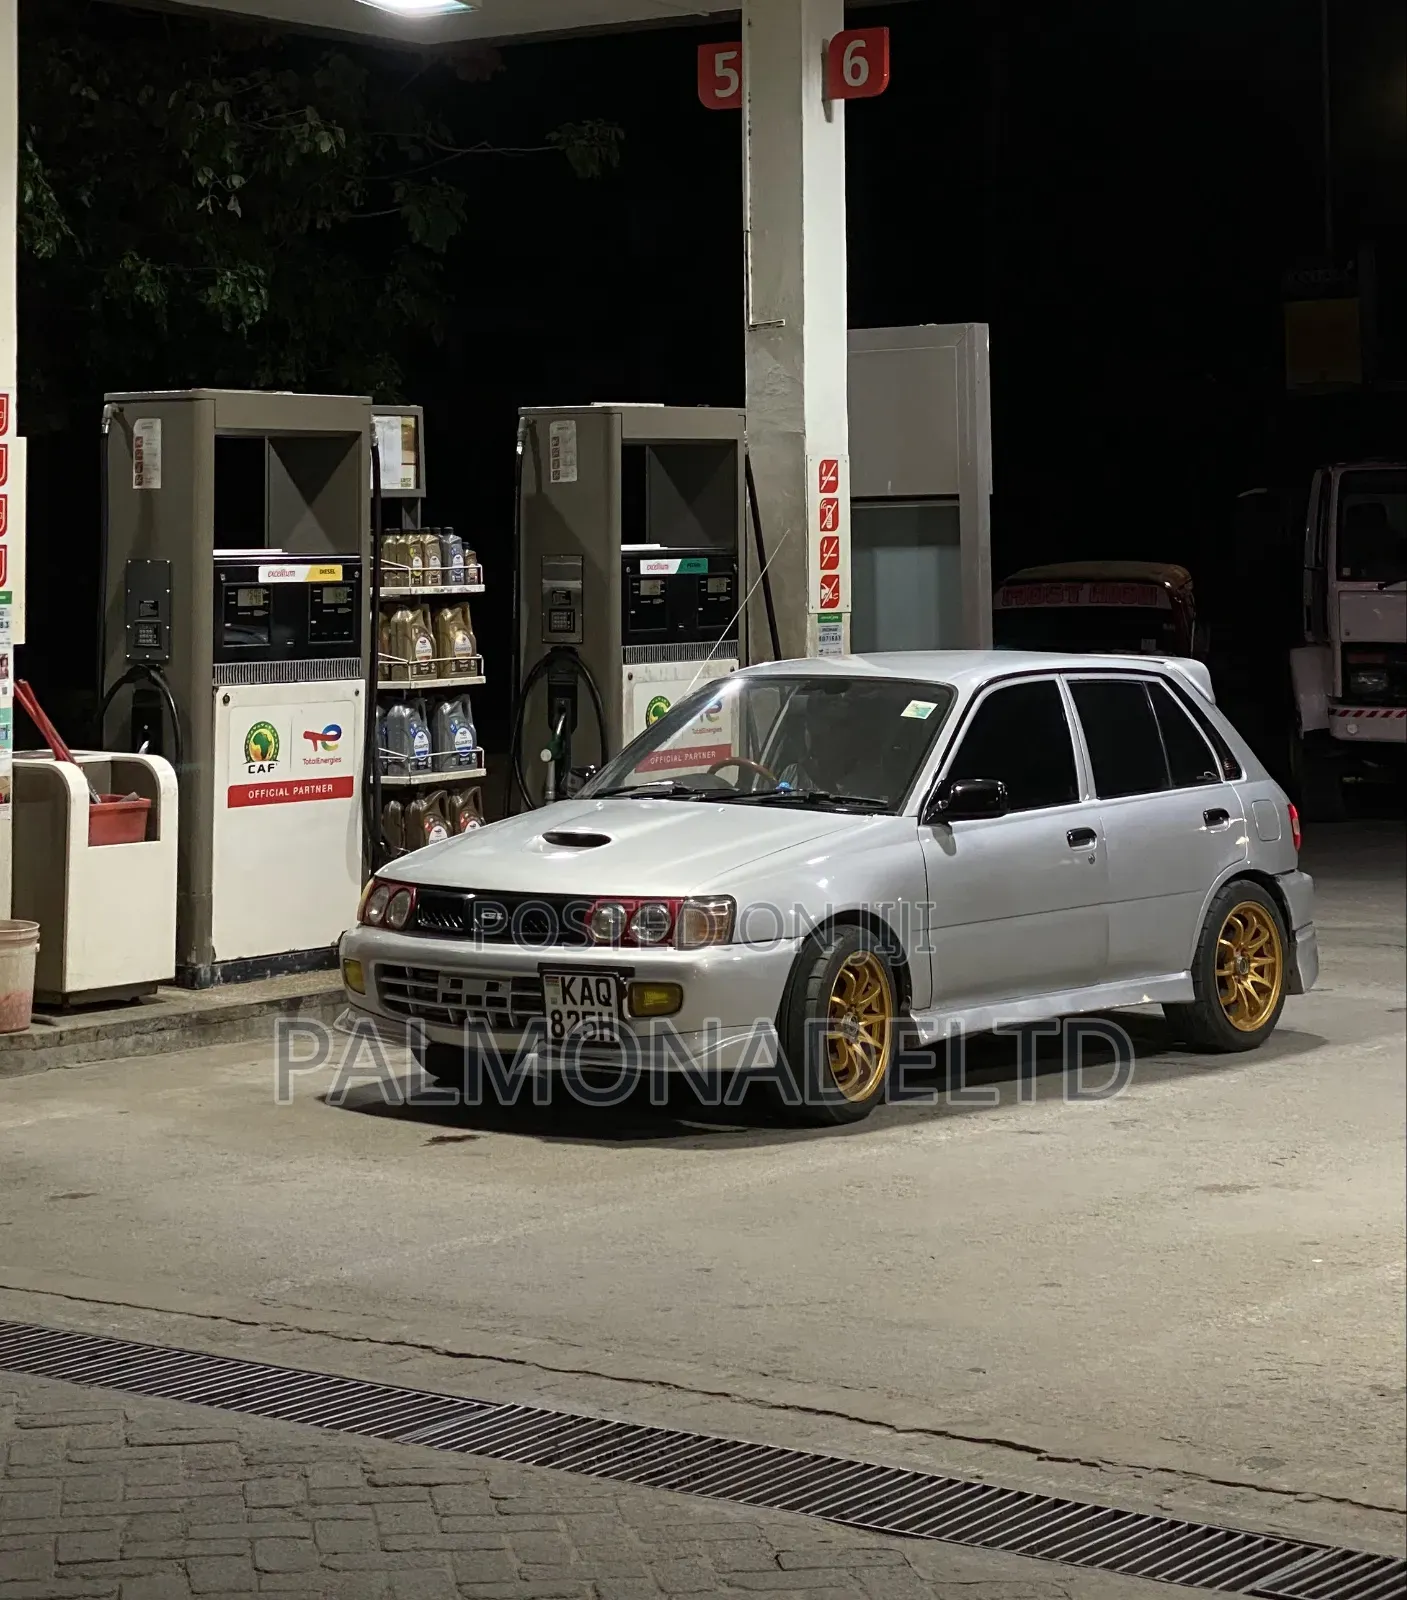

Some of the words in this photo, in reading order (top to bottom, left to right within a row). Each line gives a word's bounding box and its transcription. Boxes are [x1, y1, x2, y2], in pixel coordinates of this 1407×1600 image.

[842, 39, 869, 87] 6
[714, 50, 740, 98] 5
[267, 568, 296, 578] excellium
[1003, 583, 1083, 606] MOST
[302, 756, 342, 766] TotalEnergies
[650, 754, 682, 765] OFFICIAL
[684, 750, 716, 762] PARTNER
[248, 763, 276, 774] CAF
[248, 787, 289, 799] OFFICIAL
[293, 785, 333, 795] PARTNER
[561, 976, 612, 1007] KAQ
[550, 1009, 615, 1041] 825H
